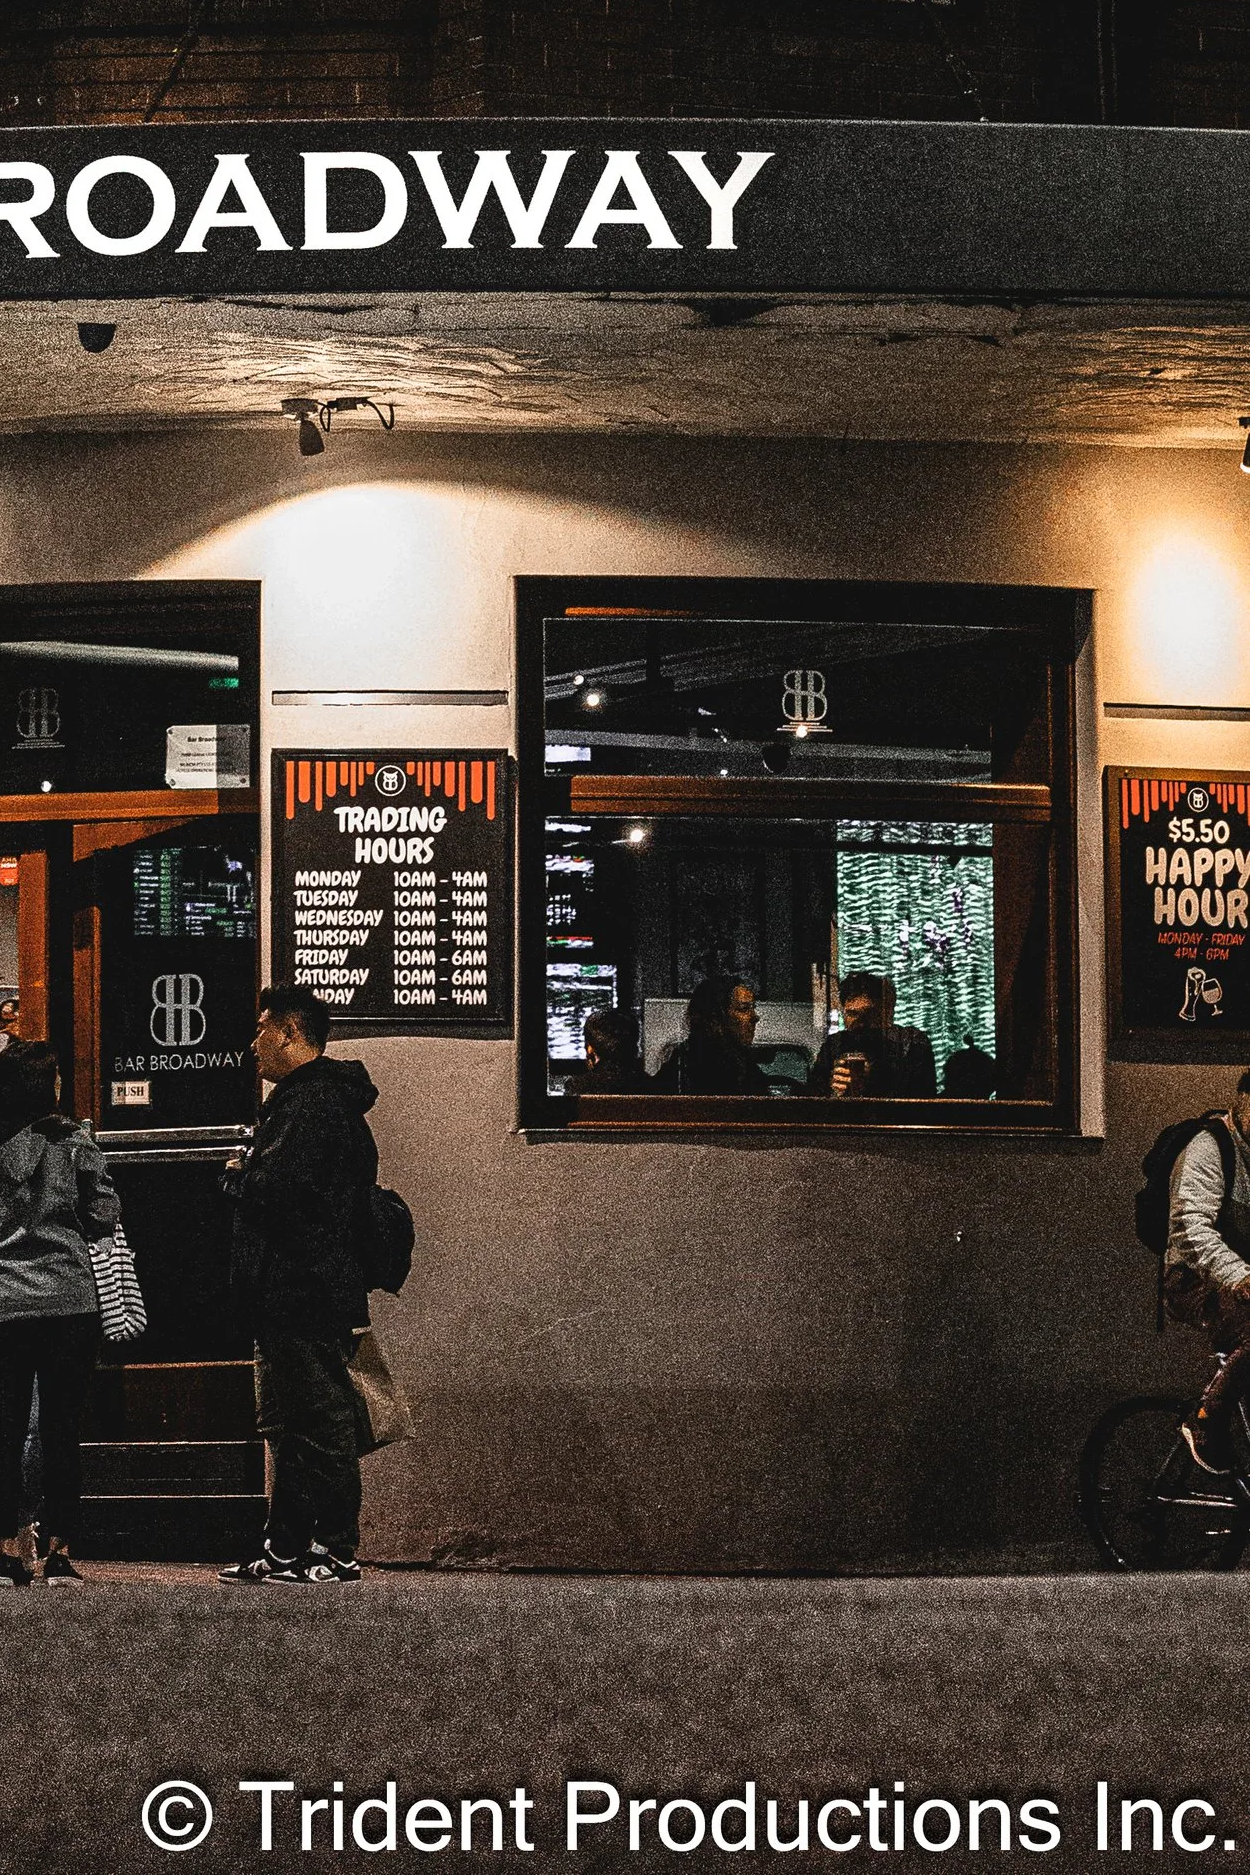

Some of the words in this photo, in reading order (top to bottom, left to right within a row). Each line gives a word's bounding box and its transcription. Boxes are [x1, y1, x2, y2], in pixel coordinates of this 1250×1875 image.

[334, 806, 447, 833] TRADING
[1169, 817, 1229, 844] $5.50
[355, 837, 434, 864] HOURS
[1146, 846, 1250, 888] HAPPY
[295, 870, 361, 887] MONDAY
[394, 871, 435, 887] 10AM
[452, 871, 487, 887] 4AM
[294, 890, 358, 906] TUESDAY
[394, 891, 435, 906] 10AM
[452, 891, 487, 906] 4AM
[1154, 888, 1249, 928] HOUR
[295, 910, 383, 926] WEDNESDAY
[394, 911, 435, 926] 10AM
[452, 911, 487, 926] 4AM
[294, 929, 369, 945] THURSDAY
[394, 930, 435, 946] 10AM
[452, 930, 487, 945] 4AM
[1158, 932, 1203, 945] MONDAY
[1211, 934, 1246, 946] FRIDAY
[295, 949, 348, 965] FRIDAY
[394, 950, 435, 965] 10AM
[452, 950, 487, 965] 6AM
[1174, 947, 1196, 958] 4PM
[1206, 948, 1229, 960] 6PM
[295, 969, 369, 985] SATURDAY
[394, 969, 435, 985] 10AM
[452, 970, 487, 985] 6AM
[313, 988, 354, 1004] NDAY
[394, 989, 435, 1004] 10AM
[452, 989, 487, 1004] 4AM
[114, 1056, 145, 1073] BAR
[150, 1051, 244, 1071] BROADWAY
[117, 1086, 145, 1097] PUSH
